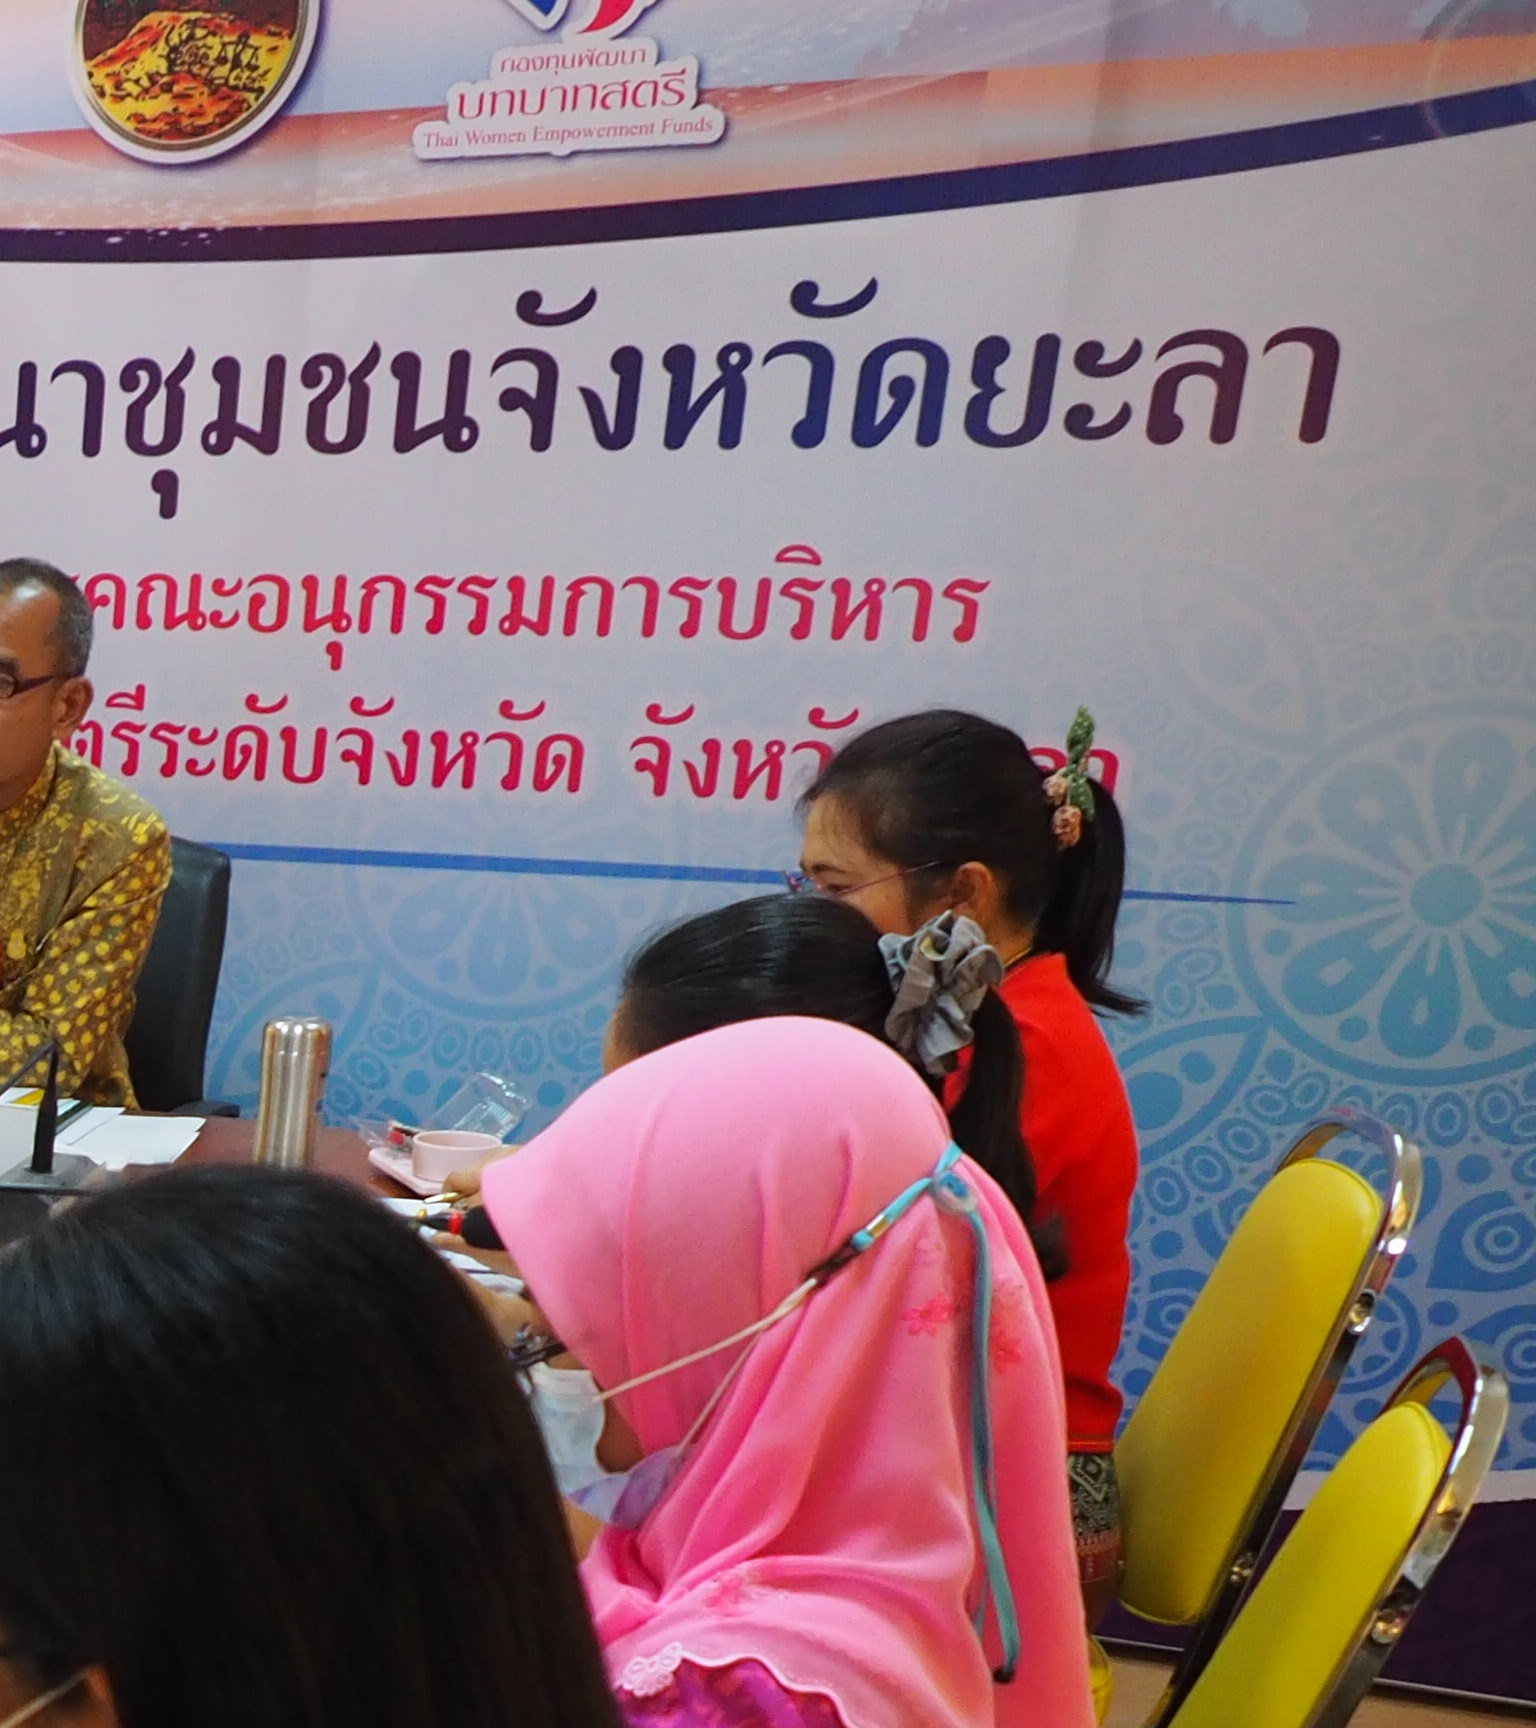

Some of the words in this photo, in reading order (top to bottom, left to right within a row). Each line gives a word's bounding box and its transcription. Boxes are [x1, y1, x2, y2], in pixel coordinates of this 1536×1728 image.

[500, 46, 647, 76] กองทุนพัฒนา
[457, 66, 688, 120] บทบาทสตรี
[424, 132, 459, 148] Thai
[465, 128, 527, 146] Women
[532, 121, 656, 145] Empowerment
[660, 116, 714, 135] Funds
